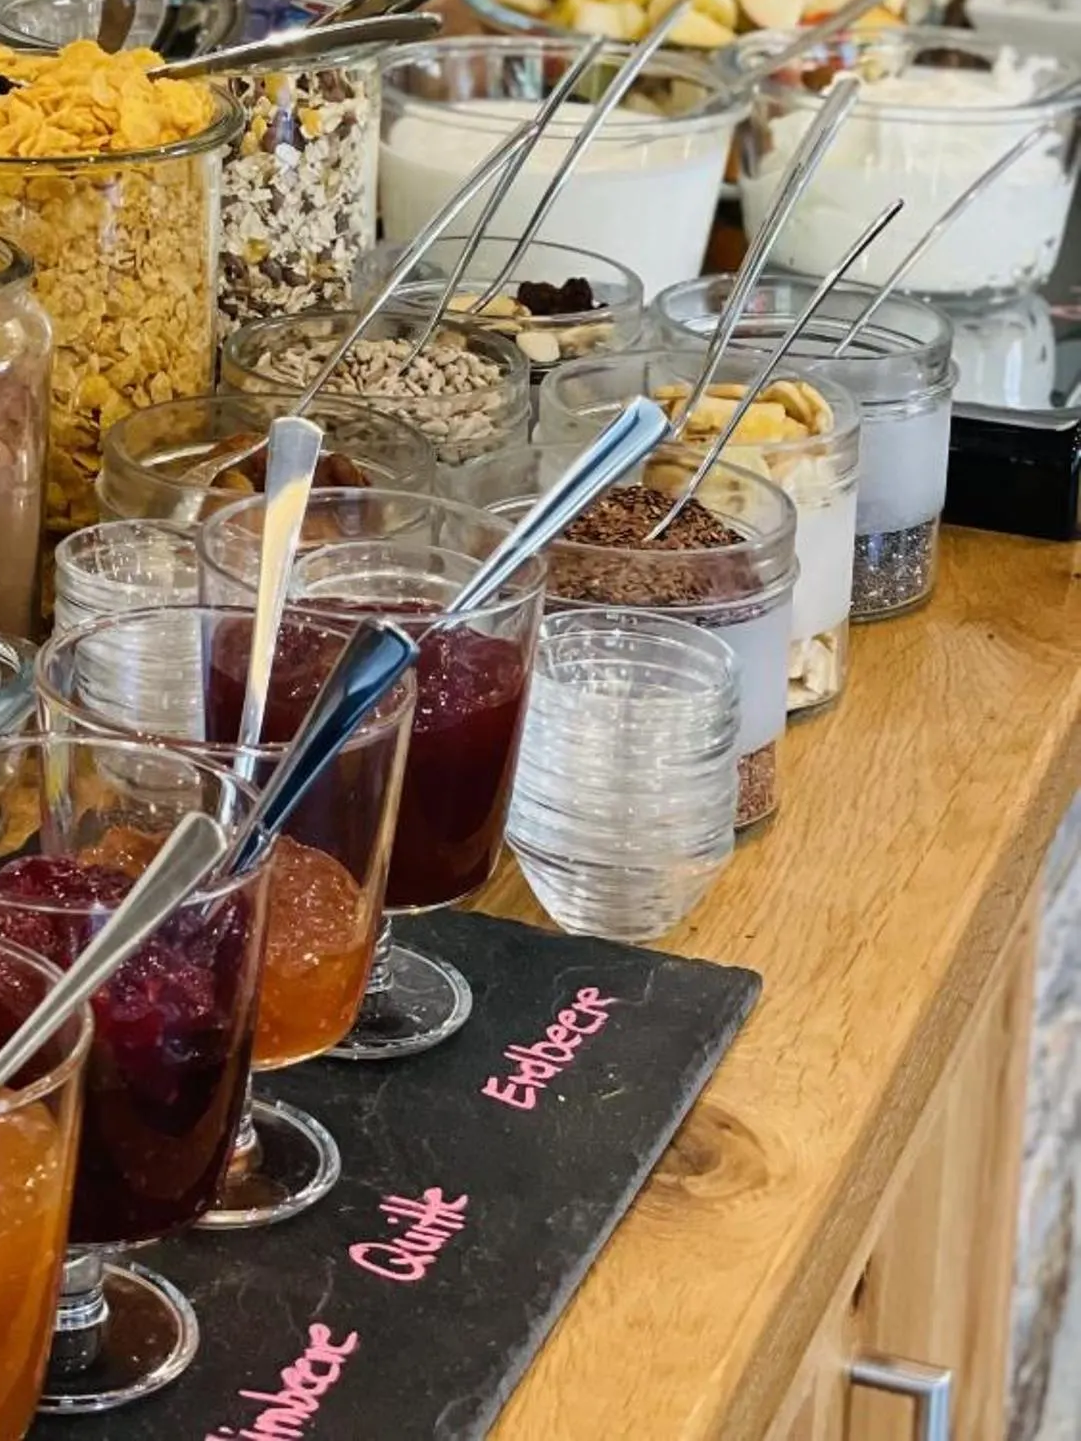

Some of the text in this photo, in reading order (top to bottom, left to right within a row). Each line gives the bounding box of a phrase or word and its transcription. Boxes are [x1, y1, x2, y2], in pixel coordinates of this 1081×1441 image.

[480, 986, 616, 1111] Erdbeere
[348, 1186, 469, 1281] Quitte
[204, 1322, 359, 1441] imbeere
